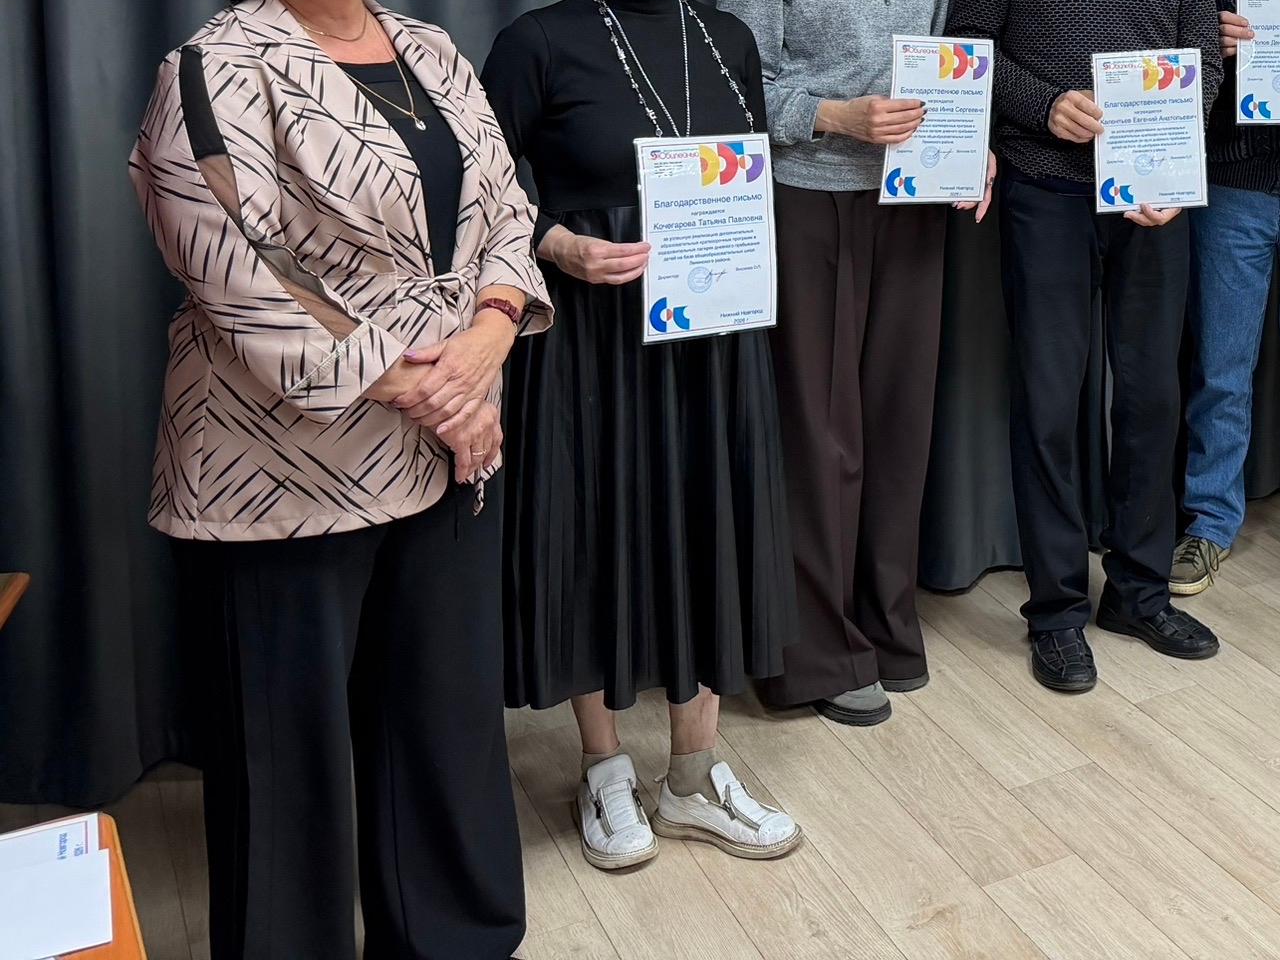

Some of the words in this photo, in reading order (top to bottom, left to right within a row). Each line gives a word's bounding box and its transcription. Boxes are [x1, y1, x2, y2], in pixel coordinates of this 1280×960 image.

[900, 87, 959, 95] Благодарственное
[1105, 98, 1167, 108] Благодарственное
[654, 194, 730, 209] Благодарственное
[732, 193, 762, 202] письмо
[654, 219, 696, 230] Кочегарова
[699, 217, 726, 225] Татьяна
[728, 213, 763, 222] Павловна
